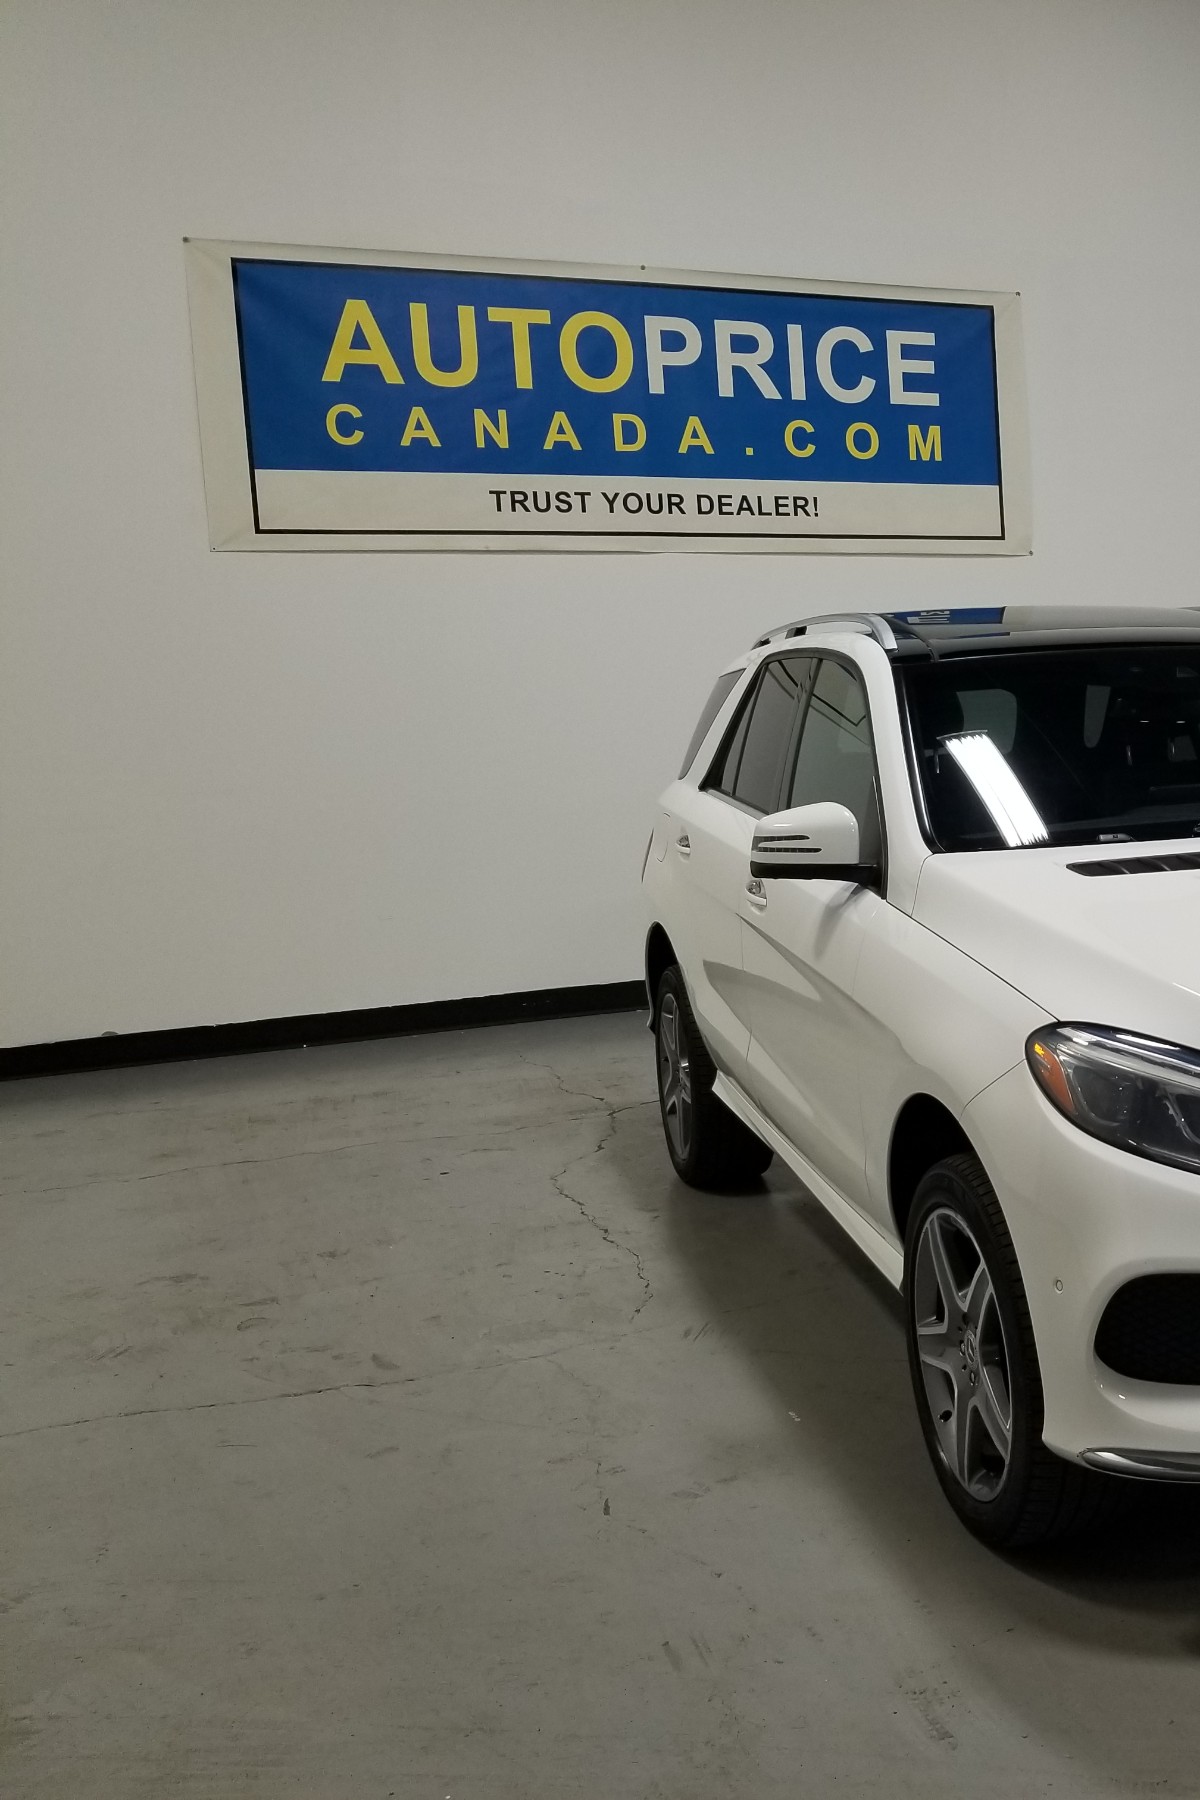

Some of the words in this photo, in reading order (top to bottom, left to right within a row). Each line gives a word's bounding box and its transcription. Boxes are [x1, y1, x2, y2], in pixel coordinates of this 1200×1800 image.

[322, 298, 940, 407] AUTOPRICE
[325, 403, 943, 462] CANADA.COM
[488, 490, 592, 514] TRUST
[600, 491, 687, 516] YOUR
[696, 493, 820, 518] DEALER!
